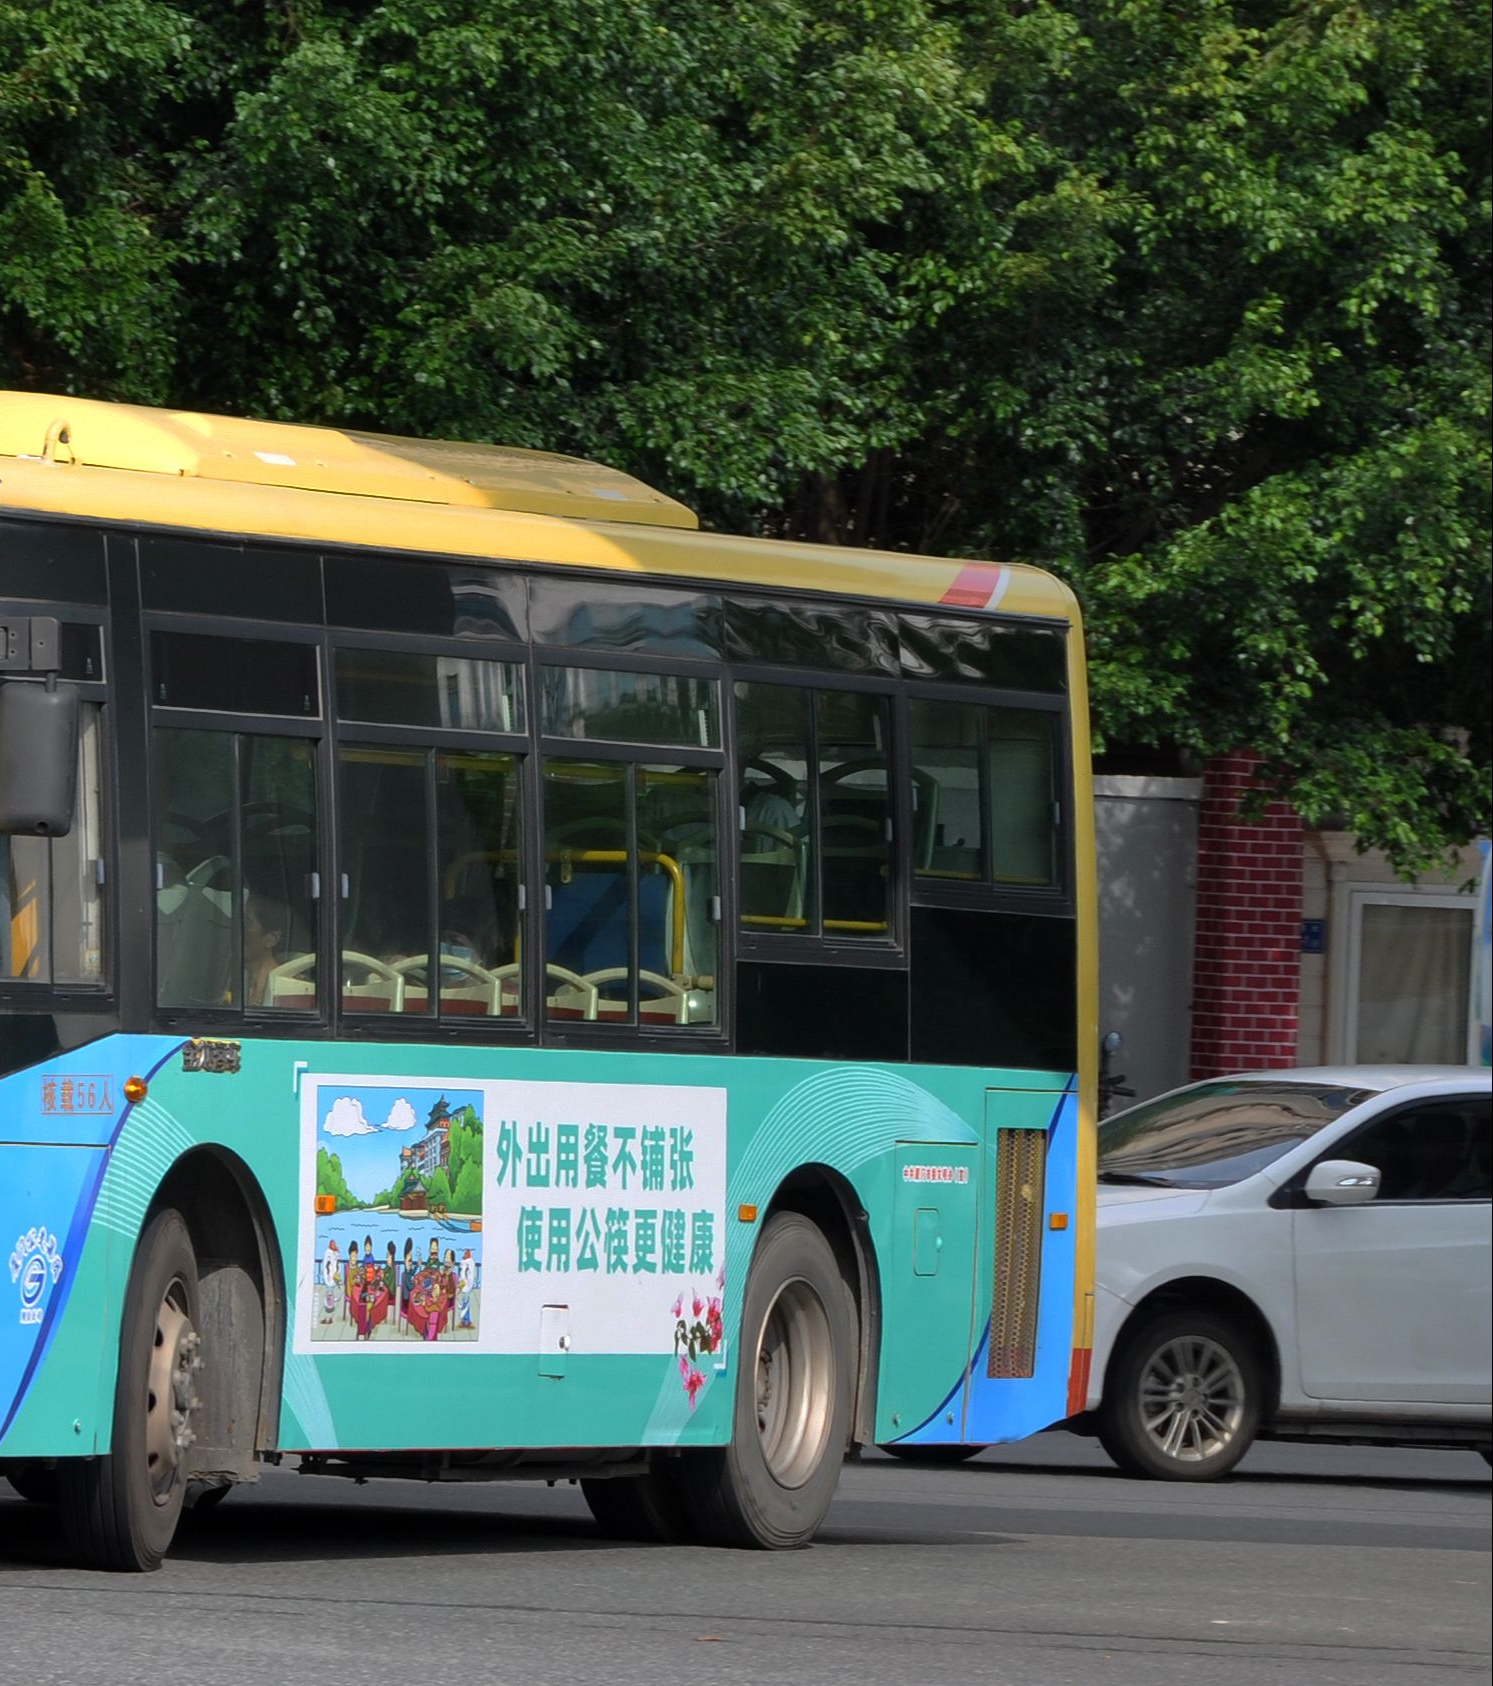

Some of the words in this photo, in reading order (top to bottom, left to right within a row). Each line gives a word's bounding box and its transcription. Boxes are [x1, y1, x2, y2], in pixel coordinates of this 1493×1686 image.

[495, 1120, 695, 1191] 外出用餐不铺张
[516, 1205, 715, 1275] 使用公筷更健康
